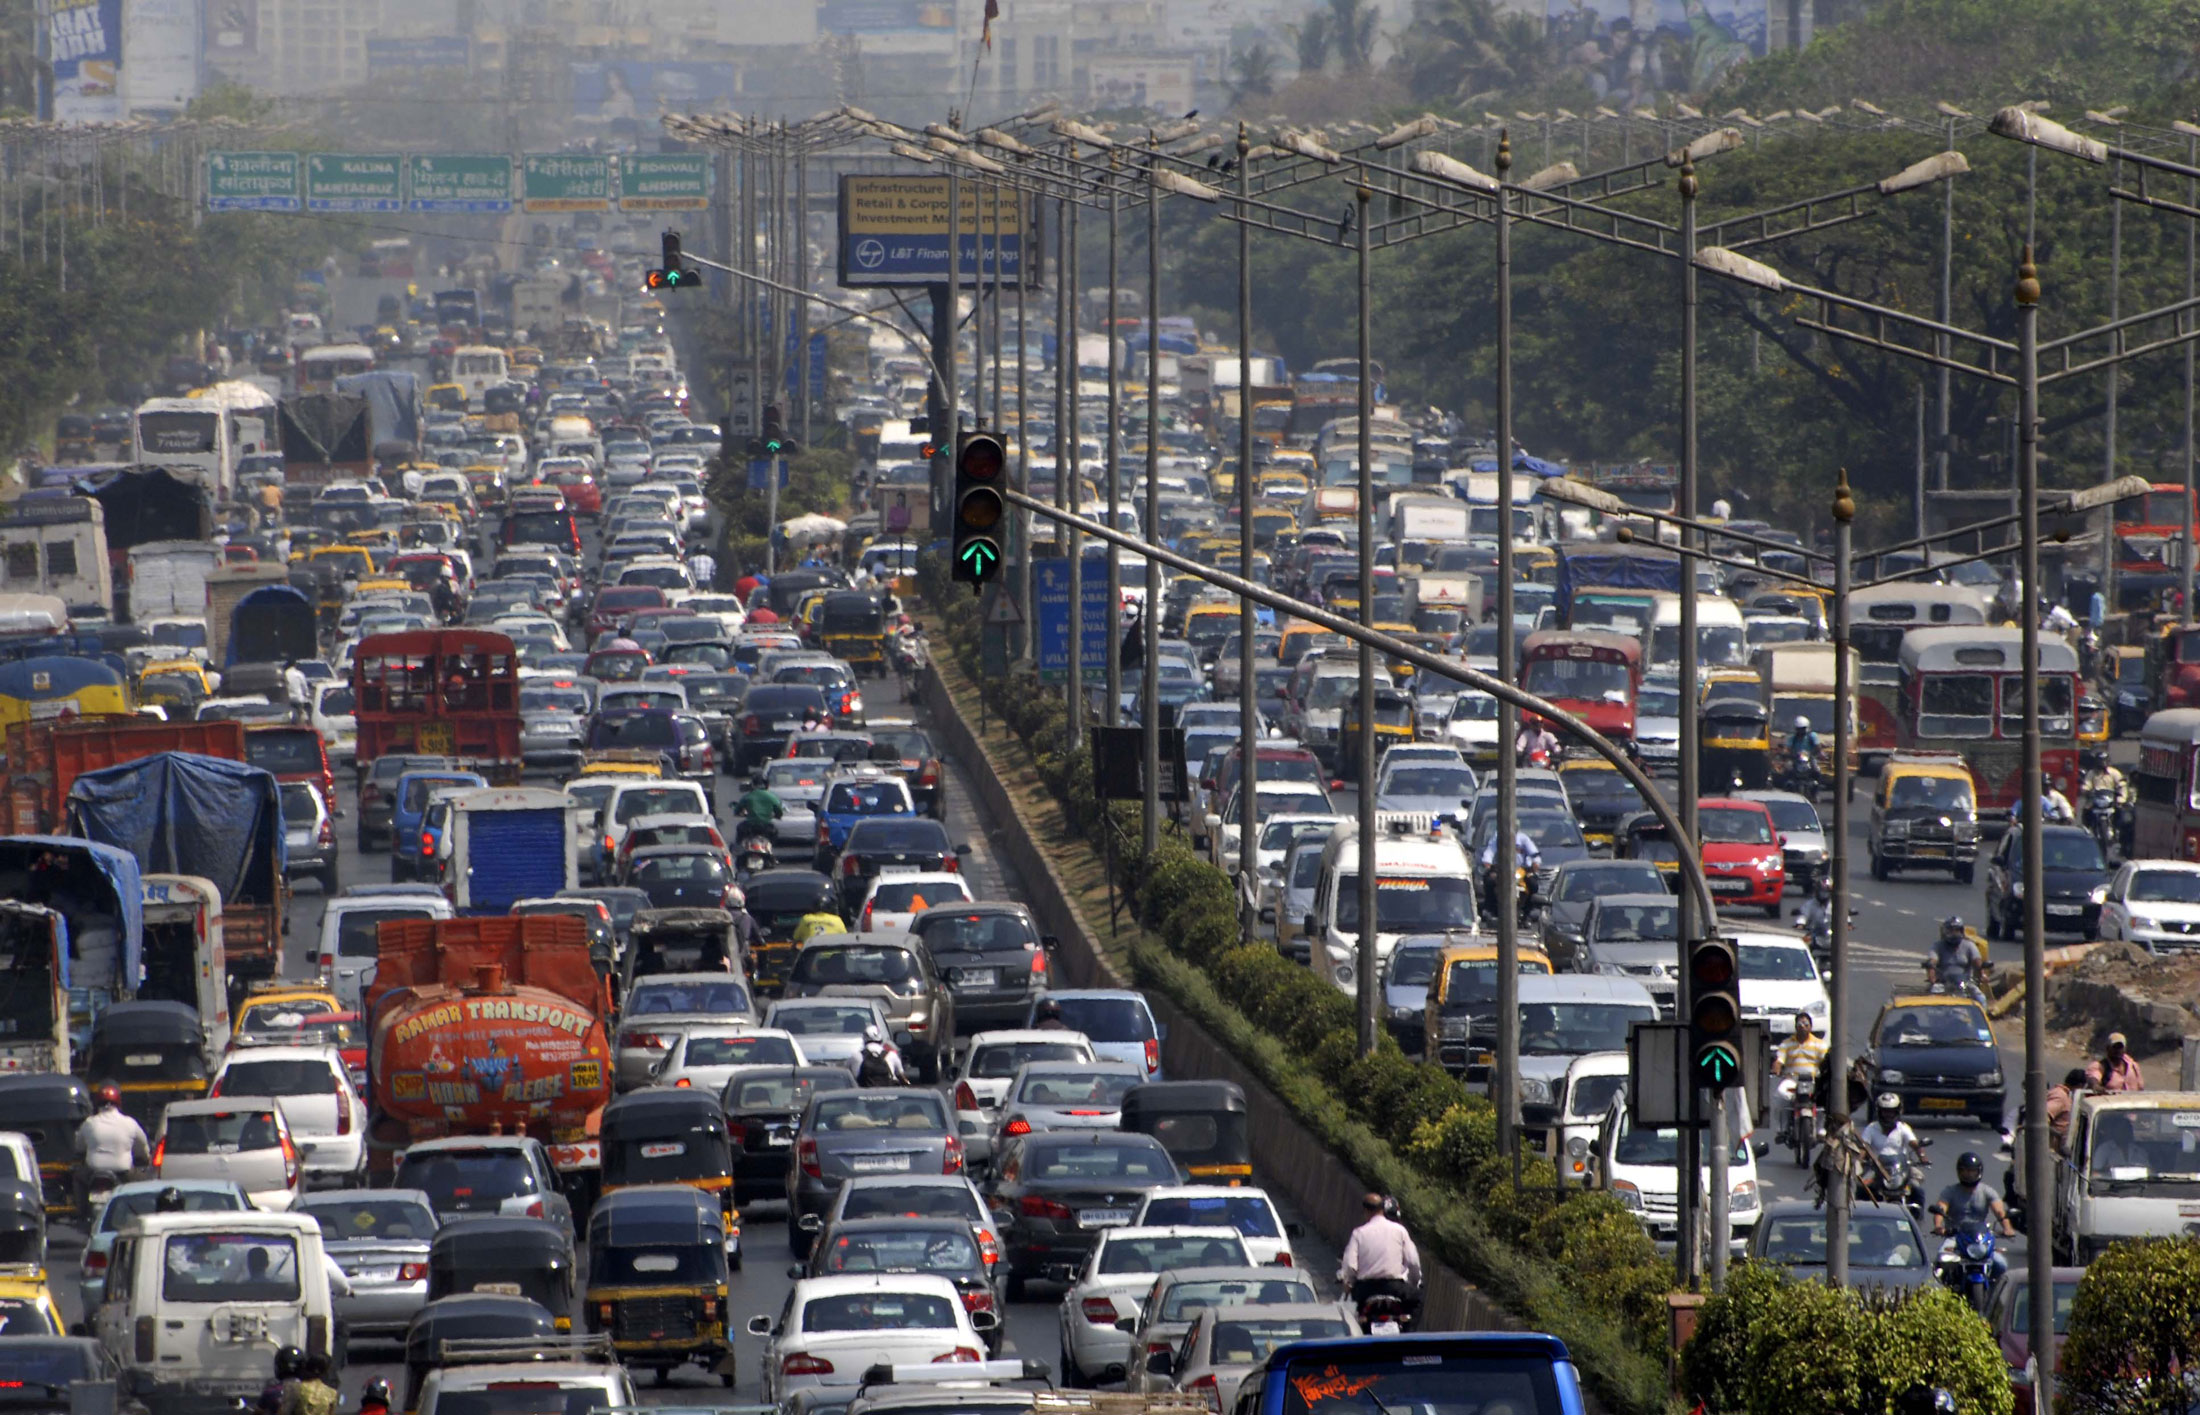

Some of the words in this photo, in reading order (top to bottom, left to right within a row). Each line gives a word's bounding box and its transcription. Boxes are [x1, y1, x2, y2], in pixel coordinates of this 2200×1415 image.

[342, 162, 395, 174] KALINA
[639, 163, 700, 173] BORIVALI
[313, 182, 395, 195] SANTACRUZ
[638, 181, 700, 192] ANDHERI
[856, 182, 943, 194] Infrastructure
[856, 199, 892, 209] Retail
[897, 200, 906, 209] &
[857, 213, 928, 224] Investment
[890, 249, 914, 259] L&T
[466, 1001, 593, 1038] TRANSPORT
[428, 1081, 481, 1104] HORN
[503, 1073, 564, 1102] PLEASE
